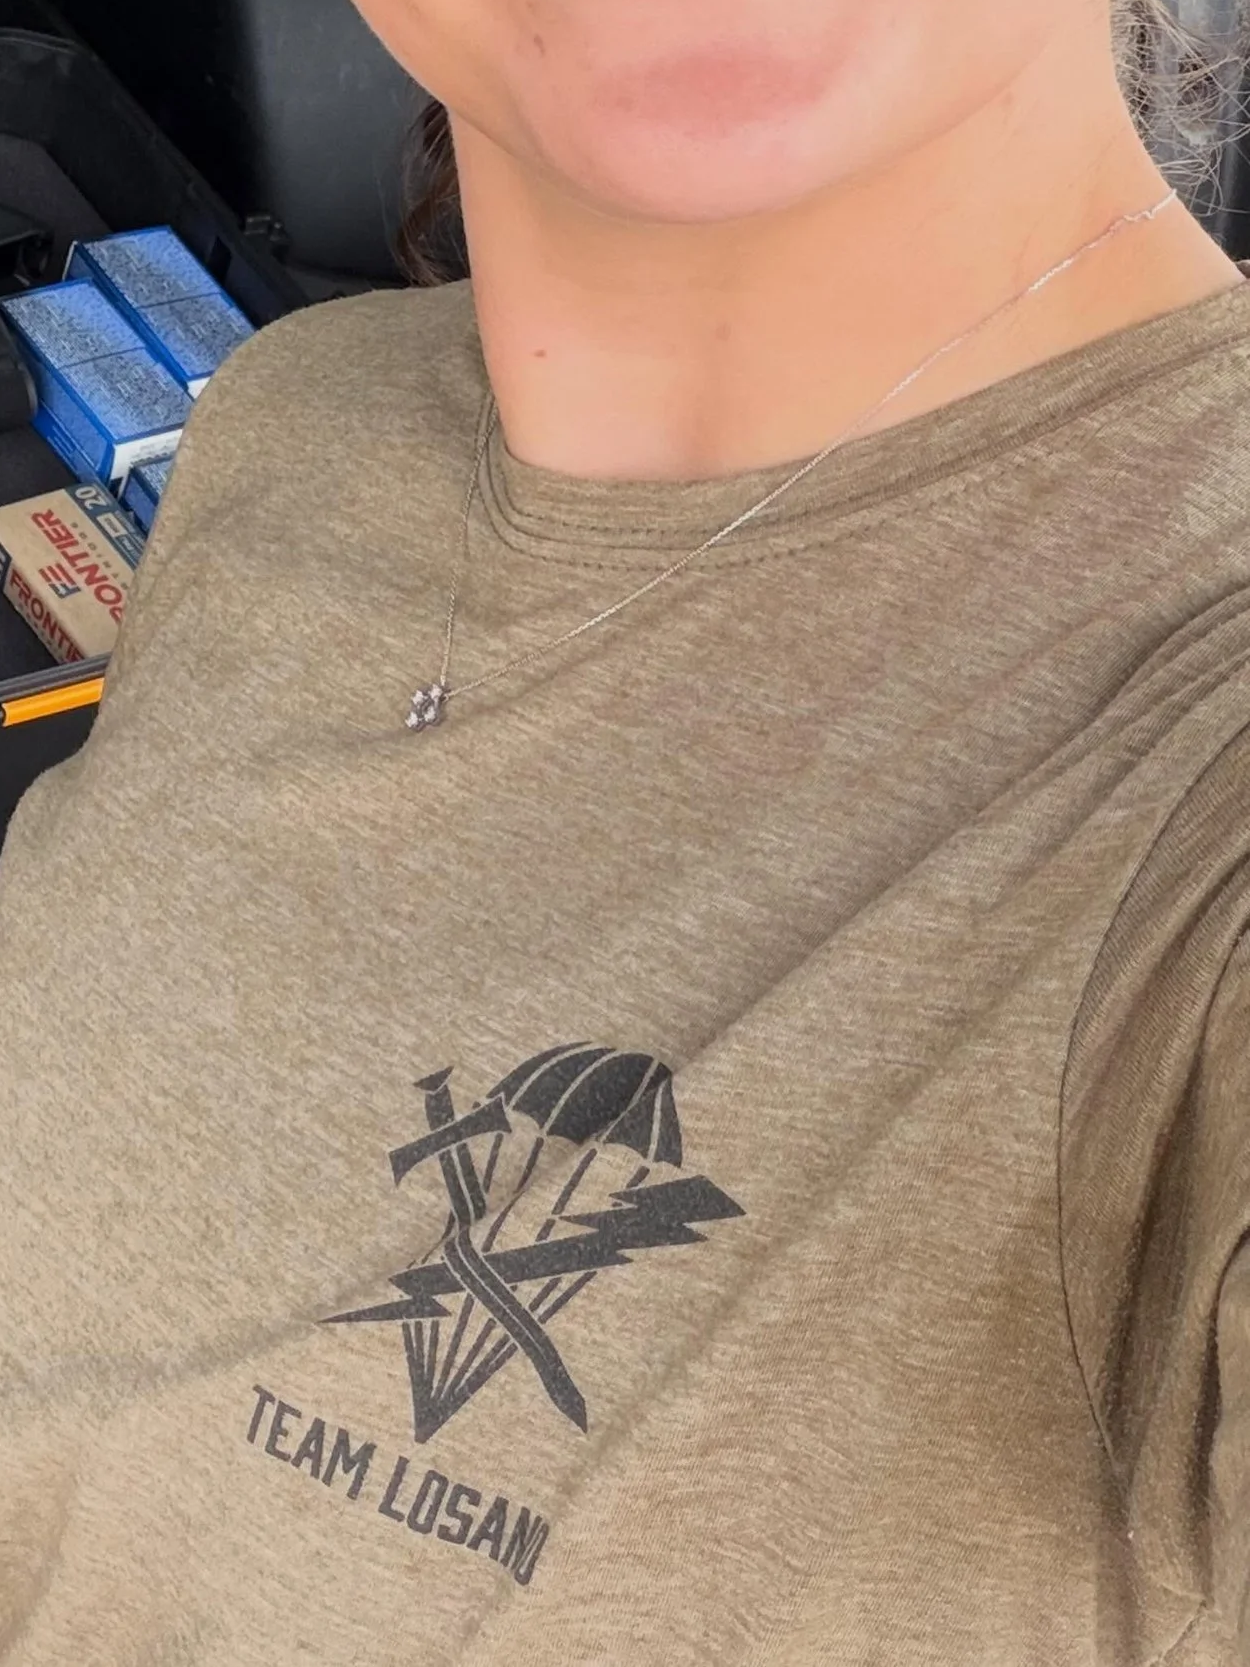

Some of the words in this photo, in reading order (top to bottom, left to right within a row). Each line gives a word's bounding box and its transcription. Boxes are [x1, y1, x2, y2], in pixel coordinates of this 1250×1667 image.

[75, 486, 108, 510] 20
[10, 569, 87, 664] FRONTIE
[31, 508, 123, 624] ONTIER
[246, 1384, 378, 1501] TEAM
